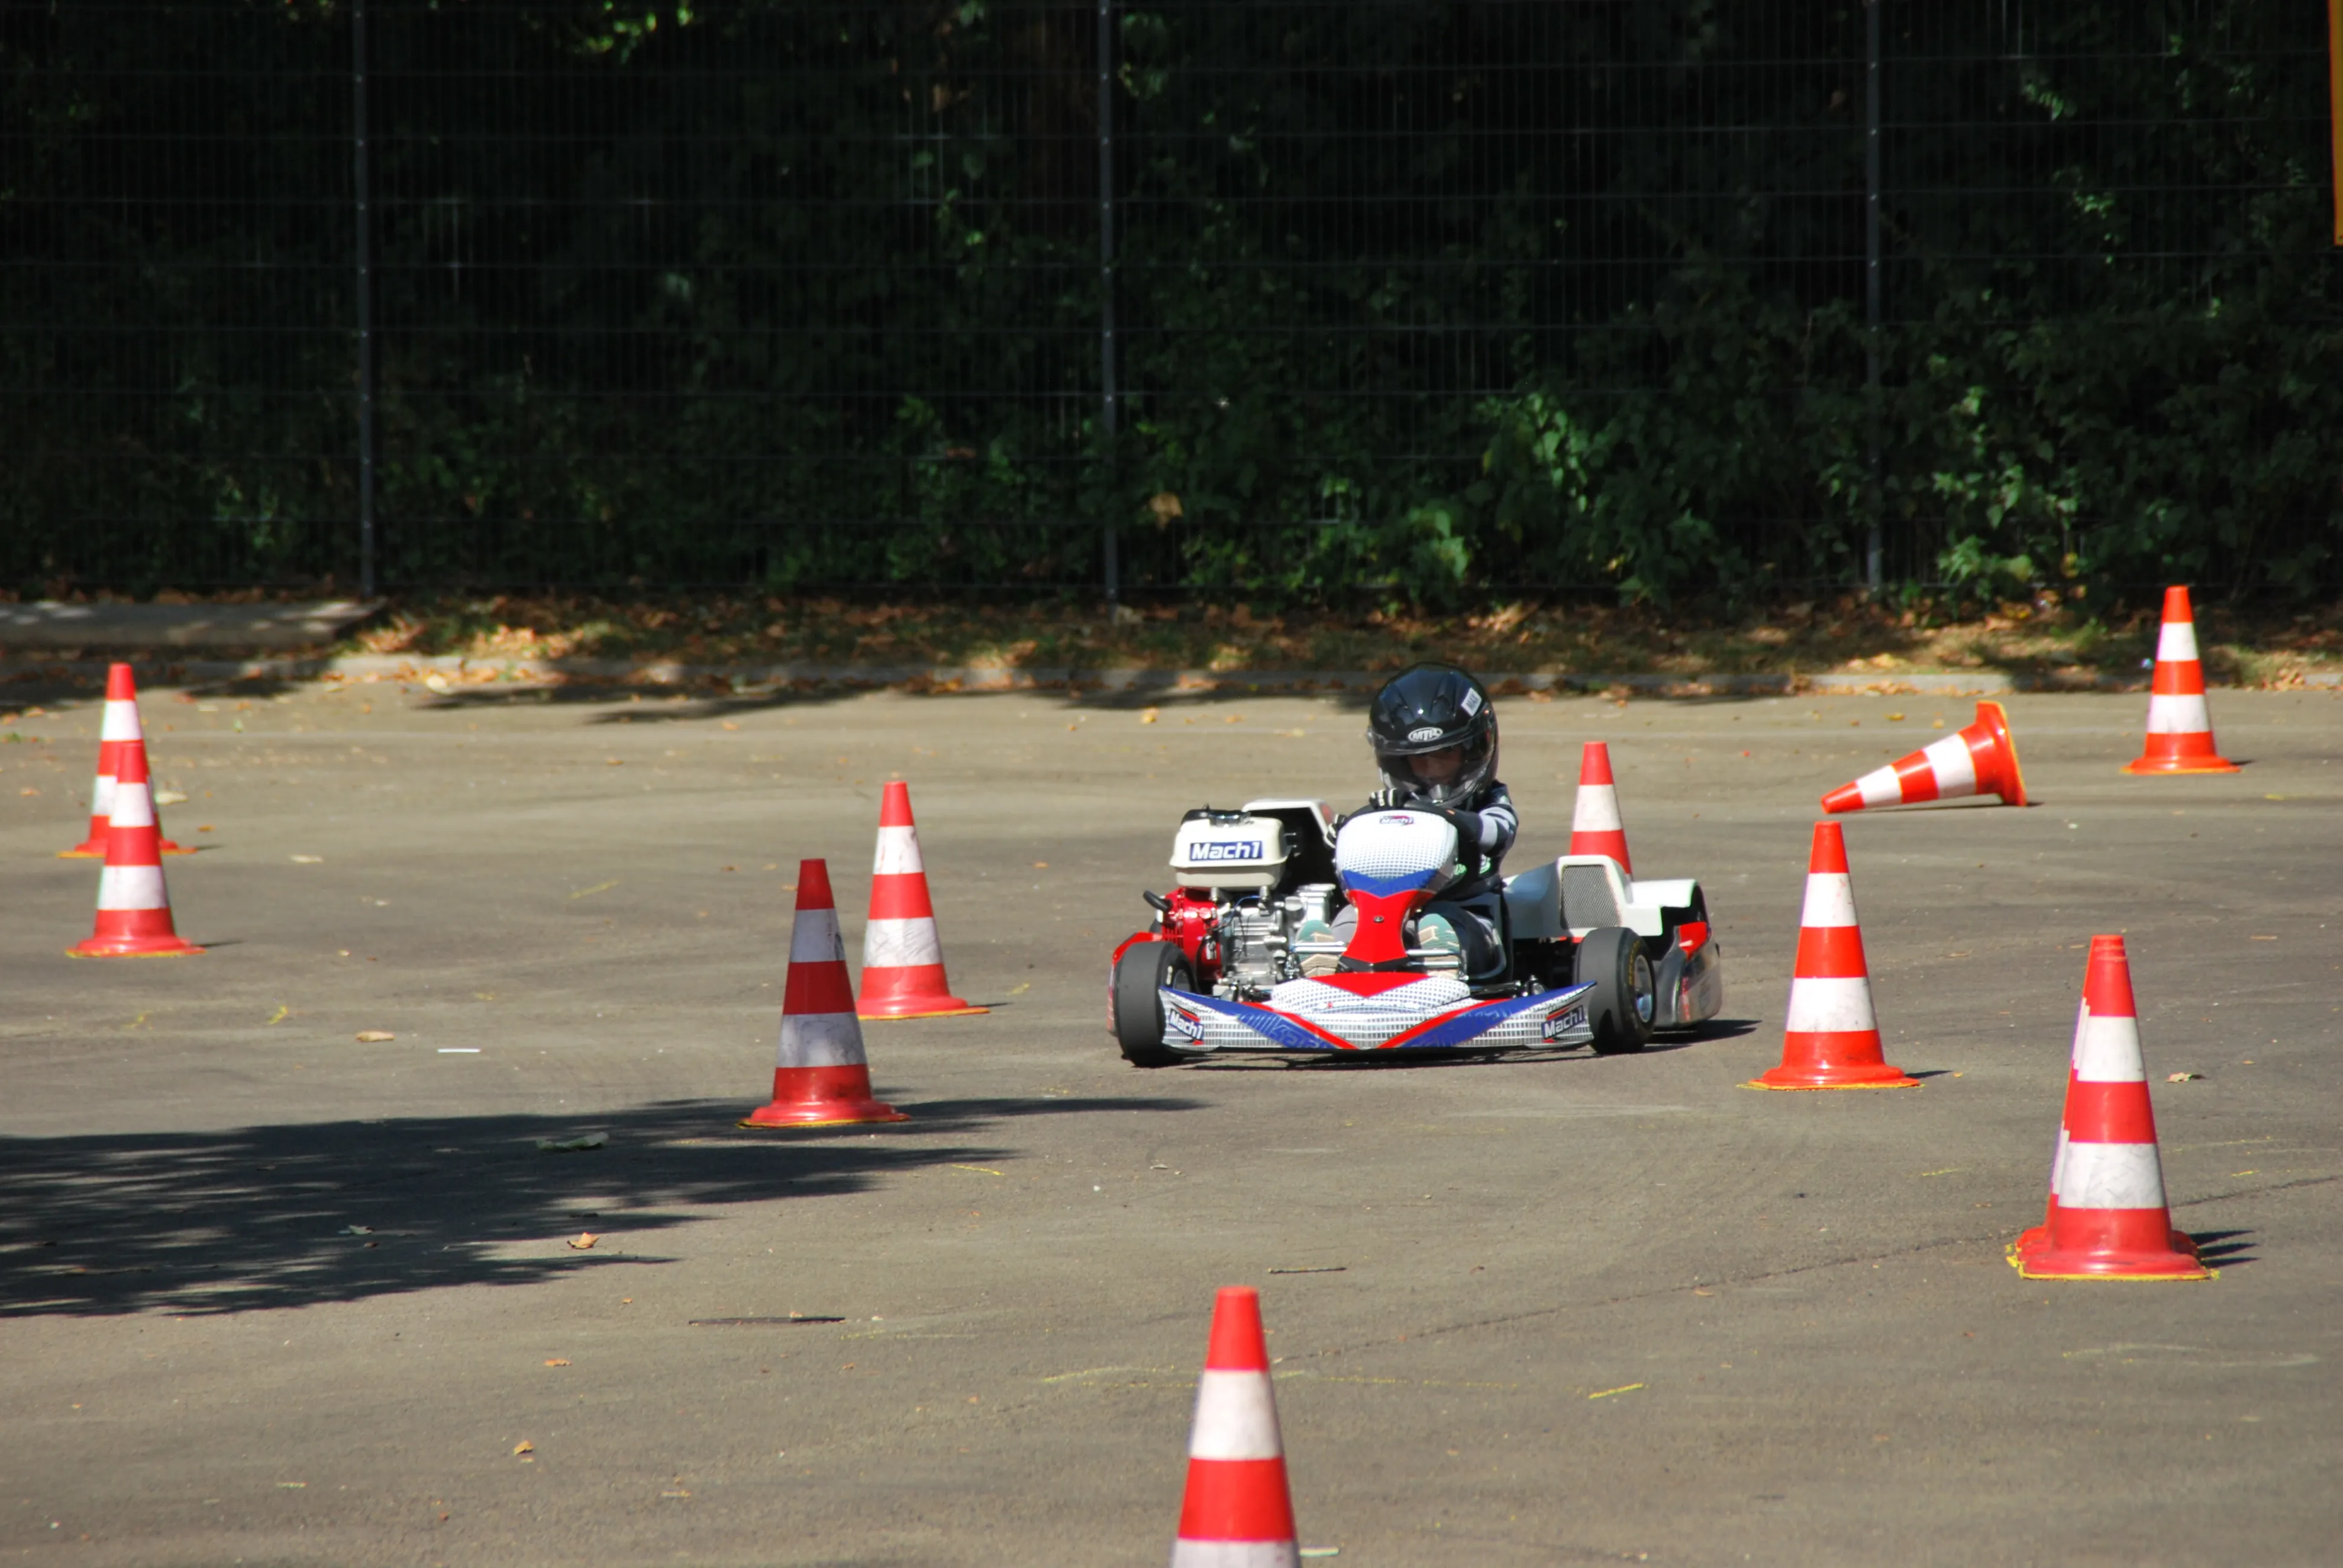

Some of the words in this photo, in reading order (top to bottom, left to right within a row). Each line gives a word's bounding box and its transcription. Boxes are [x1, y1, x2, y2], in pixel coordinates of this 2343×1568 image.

[1191, 841, 1260, 860] Mach1
[1169, 1011, 1203, 1039] Mach1
[1544, 1007, 1582, 1038] Mach1
